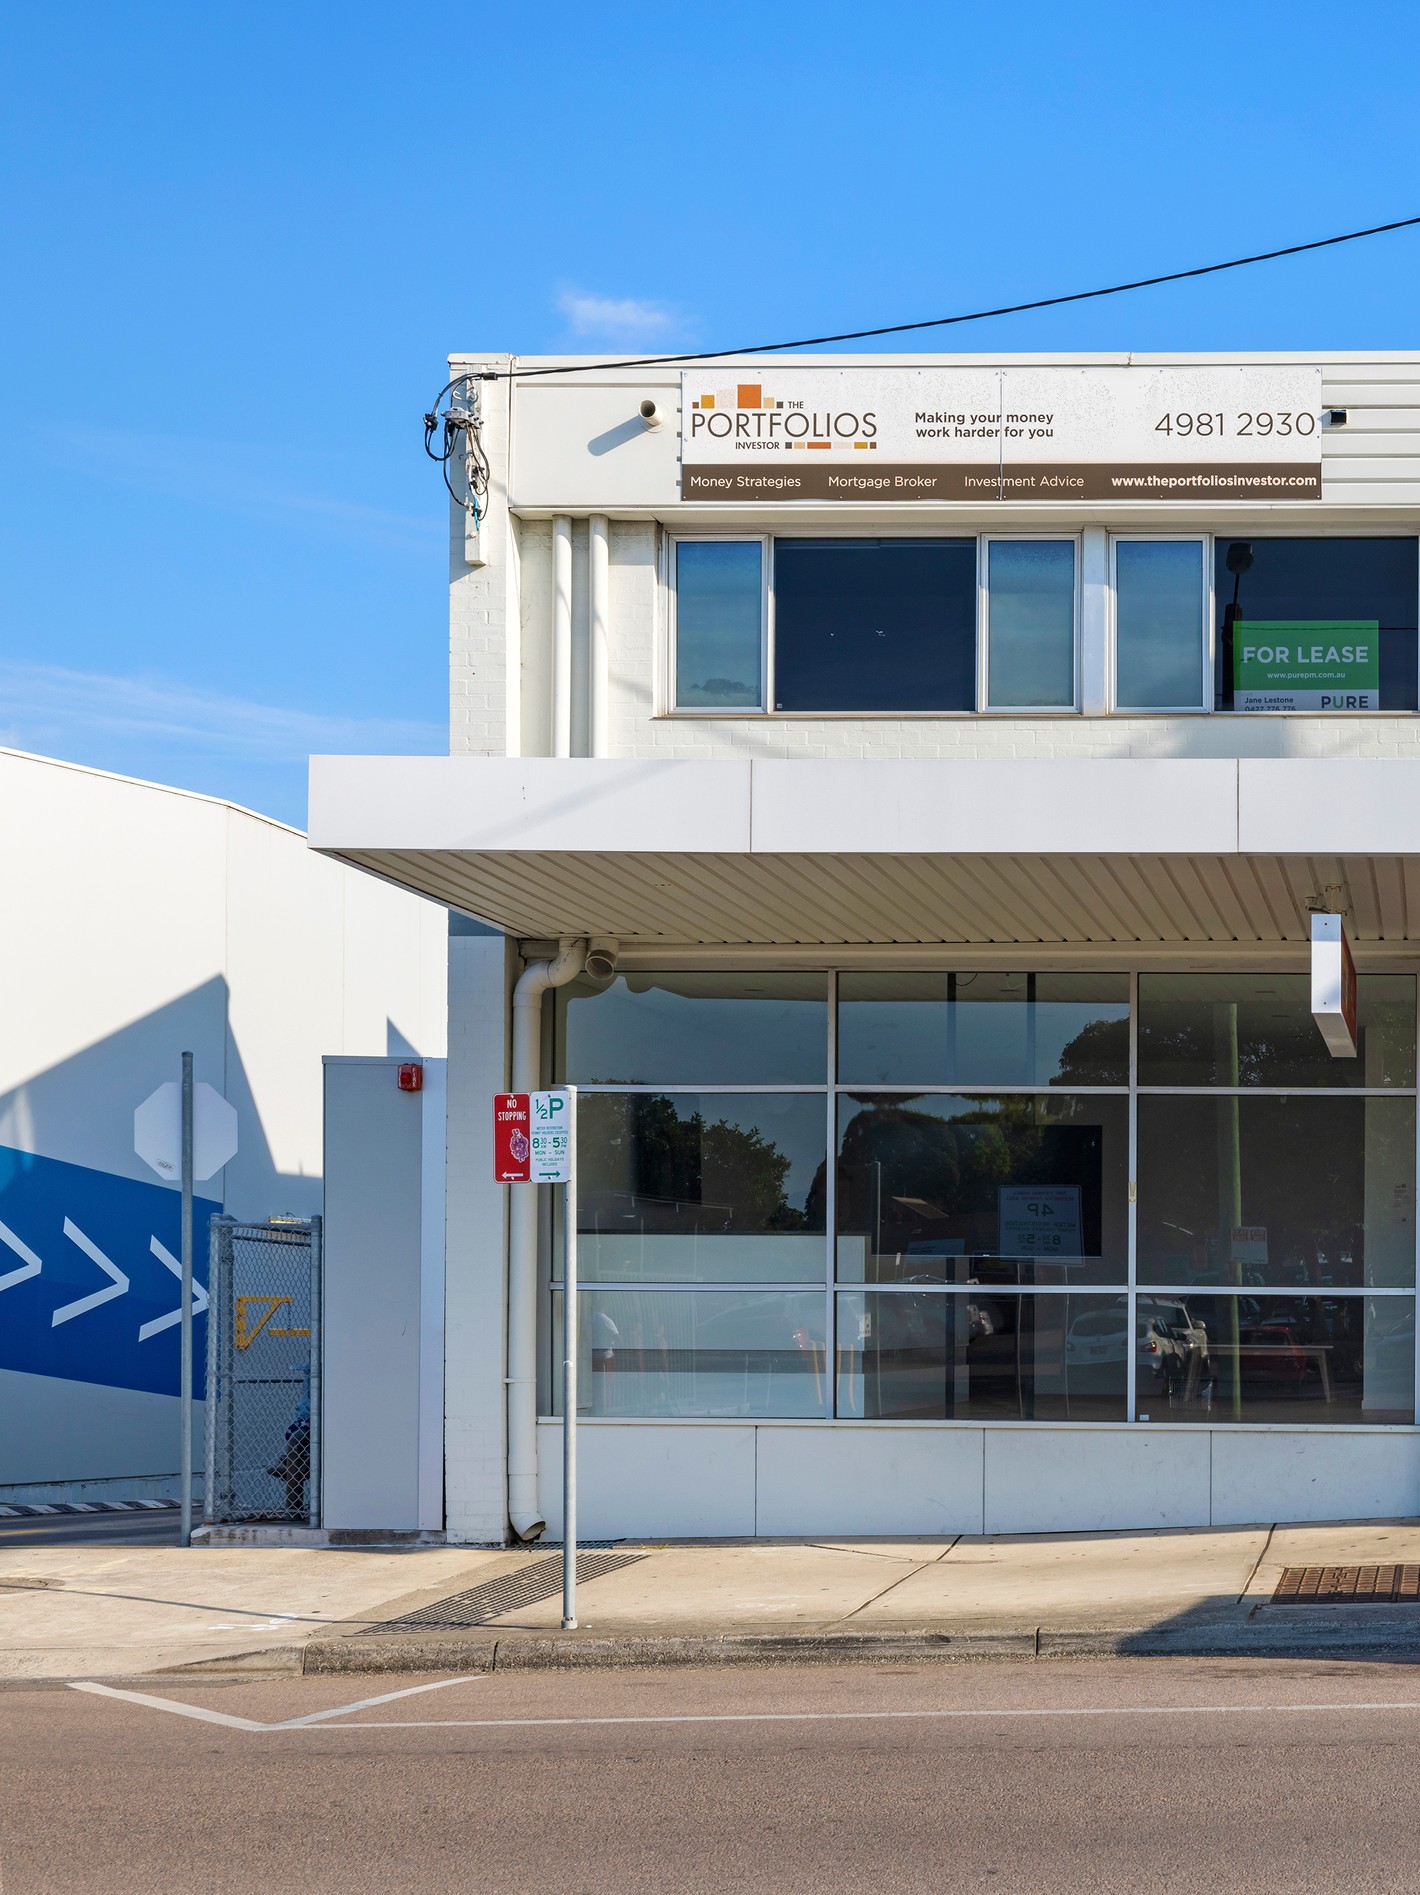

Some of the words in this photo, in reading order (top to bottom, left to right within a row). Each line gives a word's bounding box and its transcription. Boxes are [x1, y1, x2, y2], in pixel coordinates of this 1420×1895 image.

[787, 401, 804, 409] THE
[692, 412, 878, 438] PORTFOLIOS
[914, 412, 966, 425] Making
[970, 413, 1002, 425] your
[1006, 414, 1054, 425] money
[1154, 412, 1225, 436] 4981
[1236, 412, 1316, 436] 2930
[915, 427, 950, 438] work
[954, 427, 1001, 438] harder
[1004, 427, 1024, 438] for
[1028, 428, 1054, 440] you
[735, 441, 780, 450] INVESTOR
[690, 475, 733, 489] Money
[736, 475, 802, 489] Strategies
[828, 475, 891, 489] Mortgage
[894, 475, 937, 487] Broker
[964, 475, 1035, 487] Investment
[1039, 475, 1085, 487] Advice
[1111, 475, 1317, 489] www.theportfoliosinvestor.com
[1243, 646, 1290, 664] FOR
[1297, 646, 1369, 663] LEASE
[1267, 671, 1346, 680] www.purepm.com.au
[1264, 696, 1294, 704] Lestone
[1321, 696, 1369, 709] PURE
[506, 1099, 517, 1109] NO
[497, 1111, 526, 1121] STOPPING
